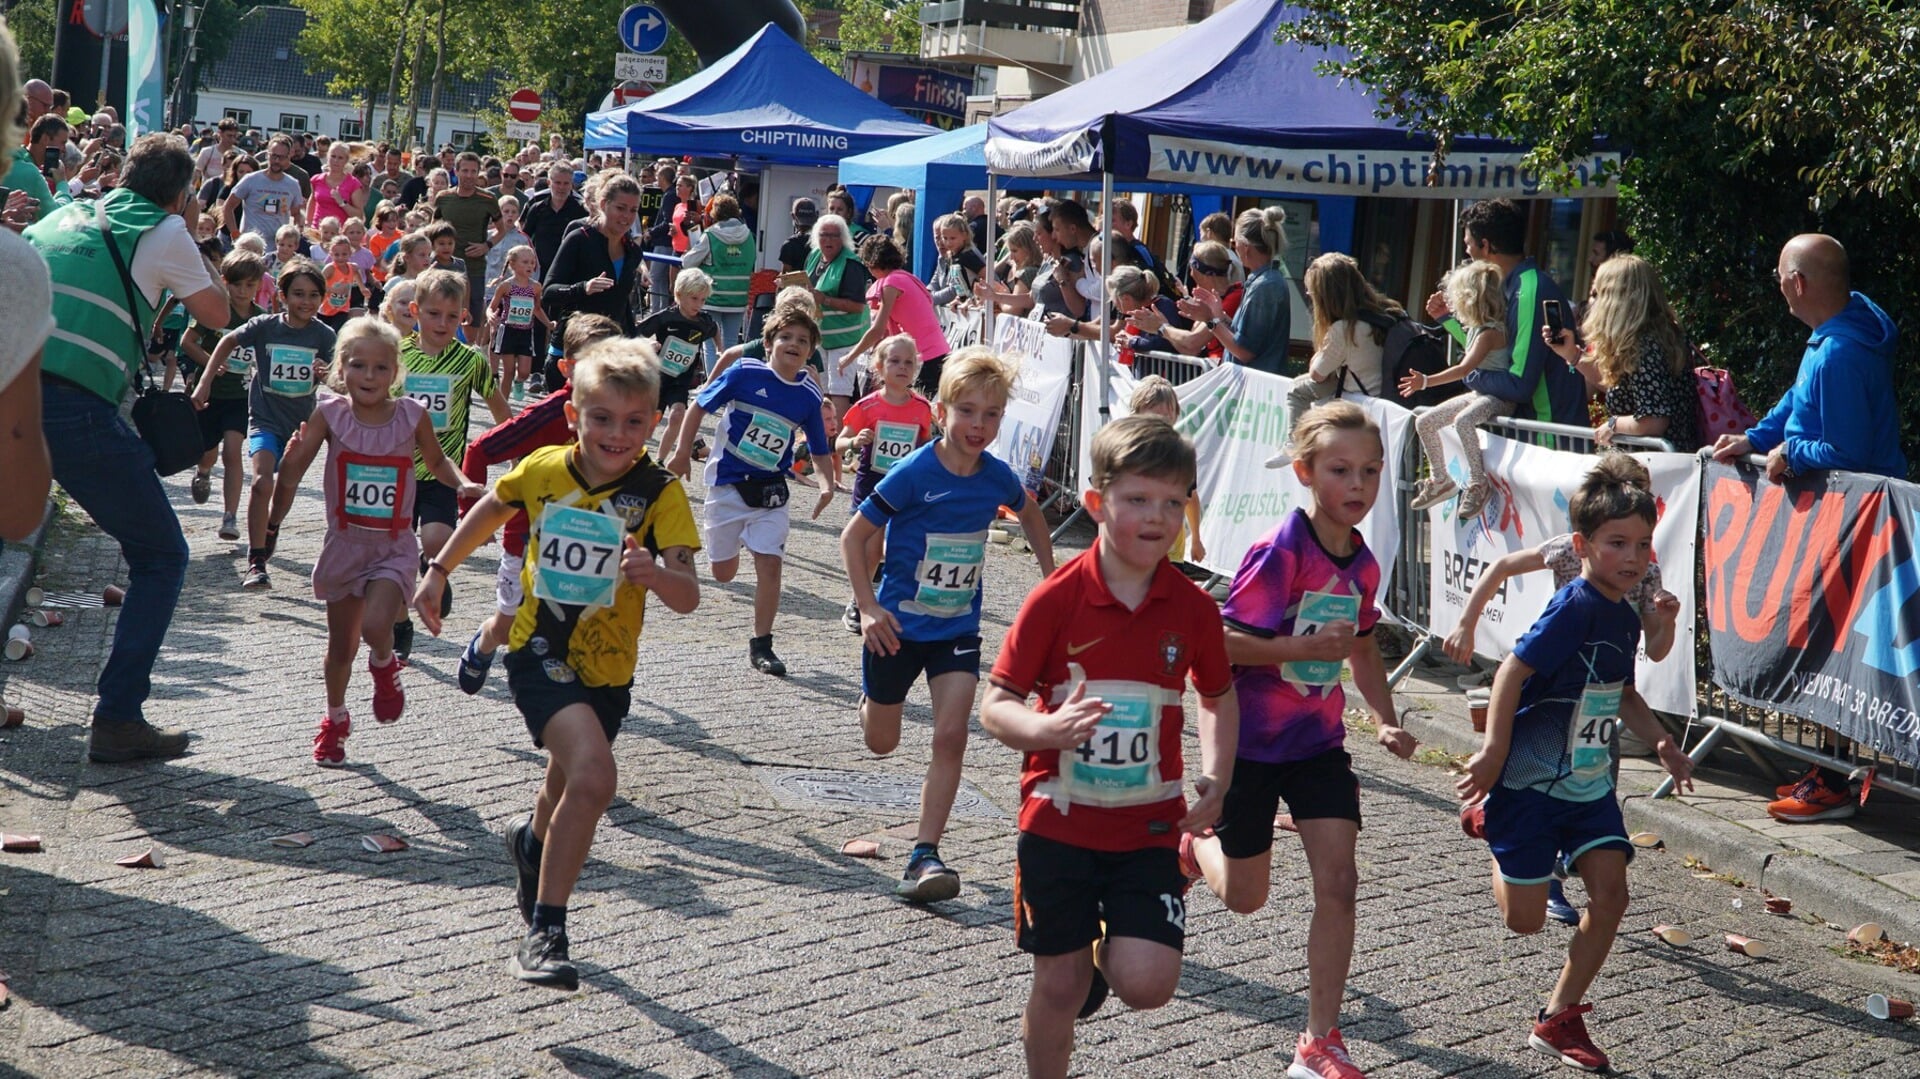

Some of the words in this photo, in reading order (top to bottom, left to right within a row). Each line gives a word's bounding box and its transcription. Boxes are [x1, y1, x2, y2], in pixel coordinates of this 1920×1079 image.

[618, 56, 665, 65] uitgezonderd
[914, 75, 965, 112] Finish
[740, 130, 848, 149] CHIPTIMING
[1164, 147, 1604, 195] www.chiptimingnl
[510, 307, 532, 316] 408
[230, 347, 253, 363] 15
[665, 350, 691, 366] 306
[272, 364, 311, 381] 419
[409, 392, 446, 411] 05
[746, 427, 784, 455] 412
[878, 441, 912, 458] 402
[347, 482, 397, 506] 406
[620, 496, 645, 507] NAC
[542, 537, 614, 575] 407
[927, 563, 977, 588] 414
[1850, 689, 1867, 716] 33
[1075, 731, 1148, 765] 410
[1160, 893, 1185, 931] 12
